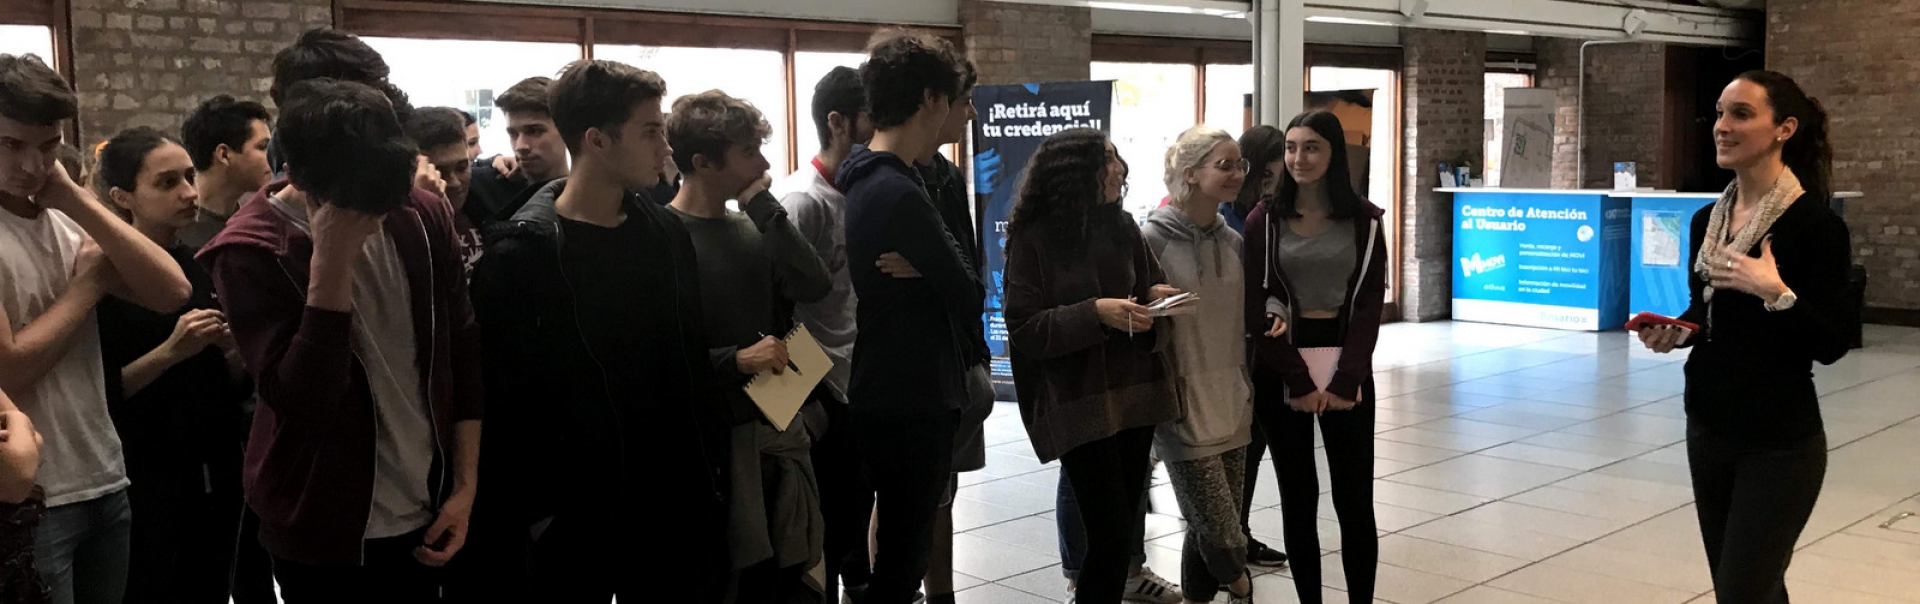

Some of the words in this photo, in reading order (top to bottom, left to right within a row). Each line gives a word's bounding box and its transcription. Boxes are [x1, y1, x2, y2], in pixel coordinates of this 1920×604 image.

[988, 102, 1047, 122] ¡Retirá
[1049, 100, 1091, 120] aquí
[983, 123, 1002, 137] tu
[1462, 205, 1505, 217] Centro
[1507, 206, 1523, 218] de
[1526, 207, 1587, 220] Atención
[1462, 218, 1473, 230] al
[1476, 219, 1526, 231] Usuario
